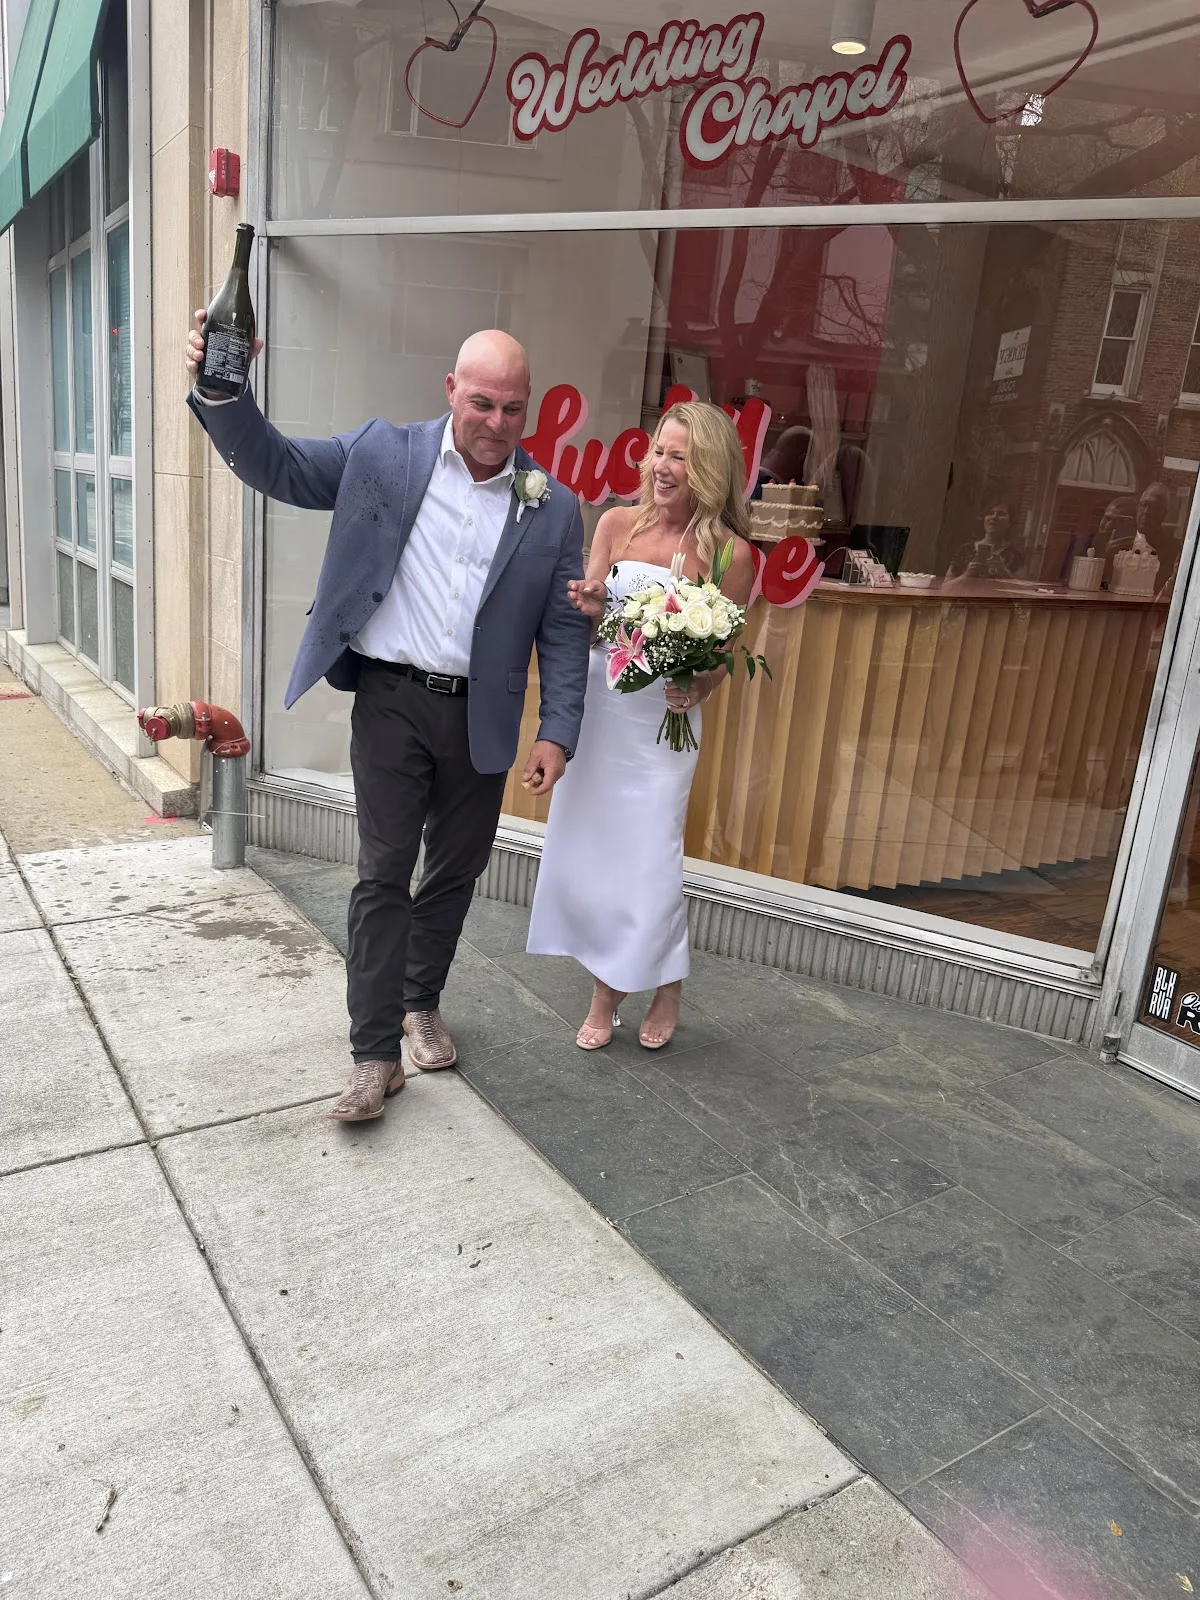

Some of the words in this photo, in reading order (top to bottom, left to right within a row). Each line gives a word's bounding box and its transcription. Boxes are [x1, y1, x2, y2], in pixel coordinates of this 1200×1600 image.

[507, 12, 764, 141] Wedding
[679, 34, 912, 170] Chapel
[1149, 990, 1171, 1019] RVA
[1153, 966, 1177, 998] BLK
